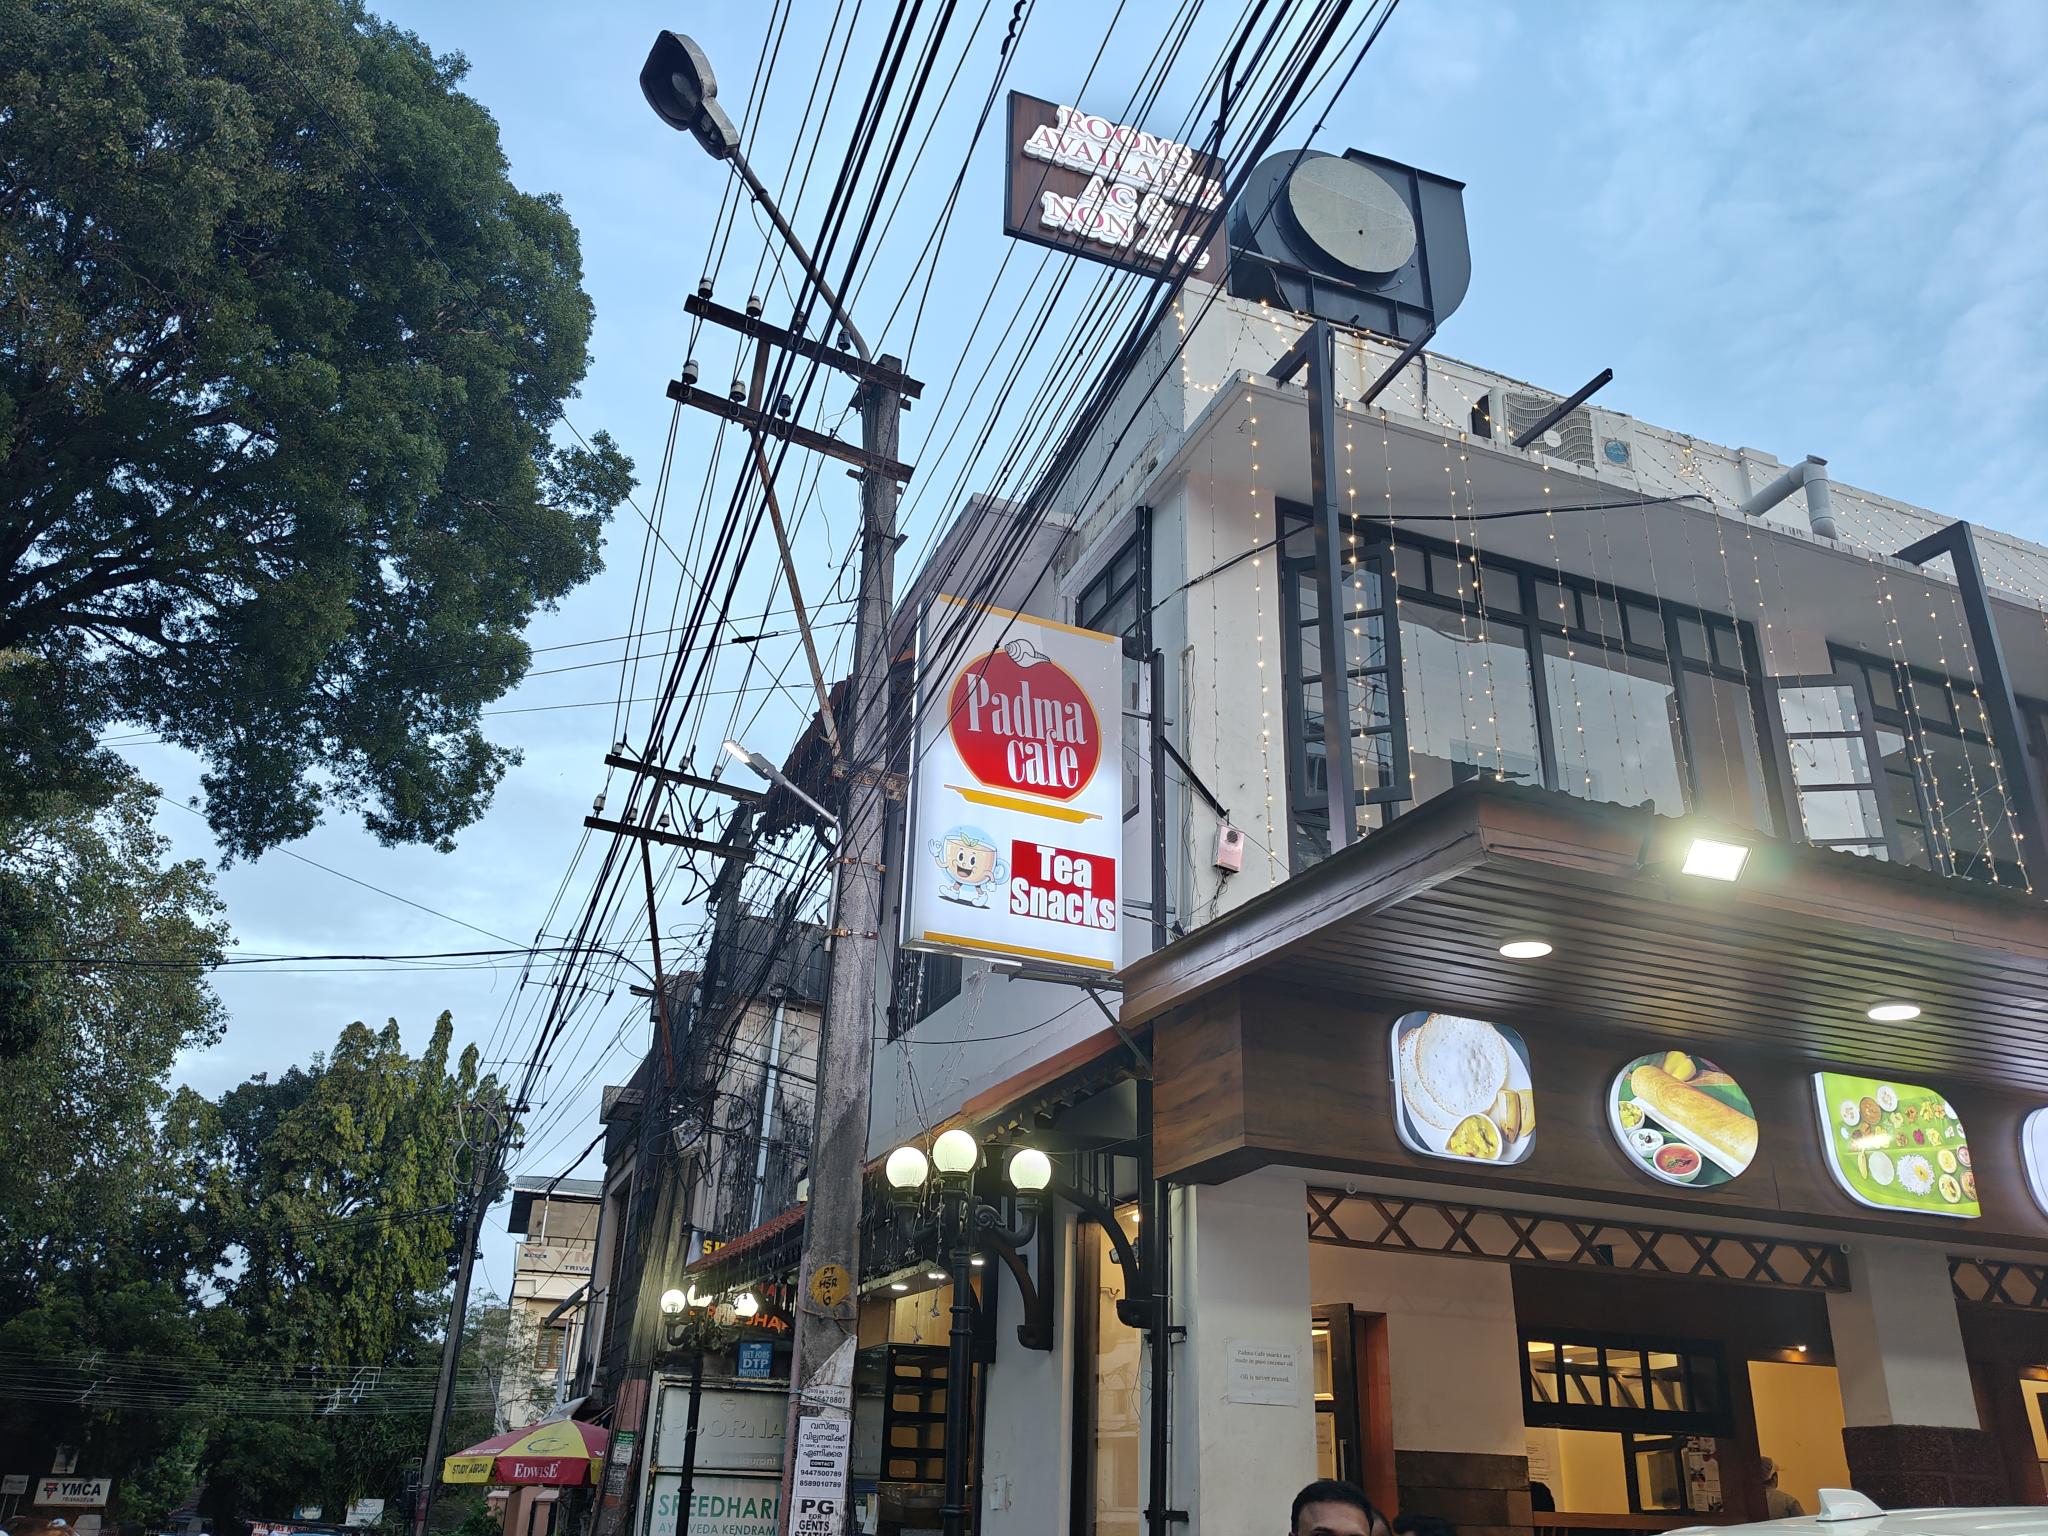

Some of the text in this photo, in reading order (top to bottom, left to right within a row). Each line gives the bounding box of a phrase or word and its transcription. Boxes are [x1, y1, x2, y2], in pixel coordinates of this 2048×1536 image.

[1059, 106, 1192, 169] ROOMS
[1083, 177, 1137, 210] AC
[1046, 193, 1137, 243] NON
[964, 673, 1088, 744] Padma
[1007, 728, 1079, 788] cafe
[1037, 845, 1092, 889] Tea
[1011, 877, 1115, 929] Snacks
[743, 1358, 769, 1369] DTP
[61, 1483, 101, 1496] YMCA
[801, 1499, 834, 1514] PG
[658, 1523, 776, 1536] AYVEDA KENDRAM
[799, 1520, 830, 1531] GENTS
